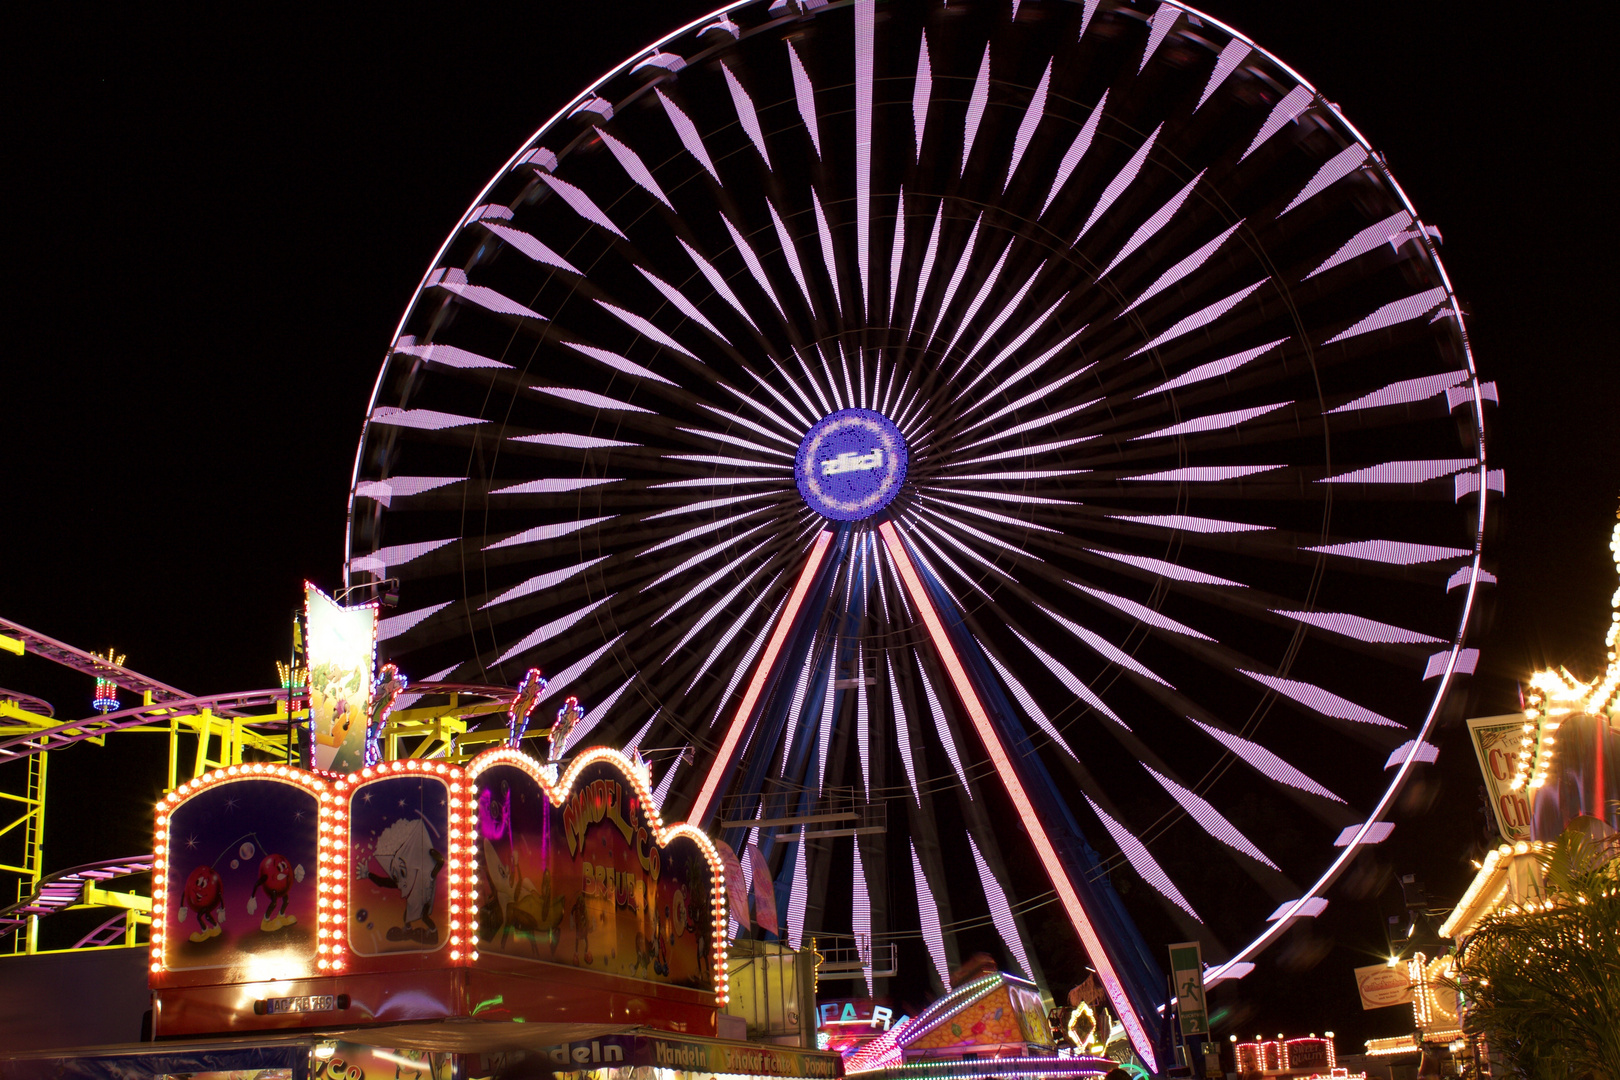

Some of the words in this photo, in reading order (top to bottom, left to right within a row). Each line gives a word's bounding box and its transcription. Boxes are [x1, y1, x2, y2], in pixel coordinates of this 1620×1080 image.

[563, 779, 634, 857] MANDEL
[581, 861, 649, 912] BREUER
[1190, 1019, 1200, 1032] 2
[655, 1041, 708, 1068] Mandeln
[1292, 1052, 1324, 1065] QUALITY
[1293, 1044, 1319, 1055] SWEET
